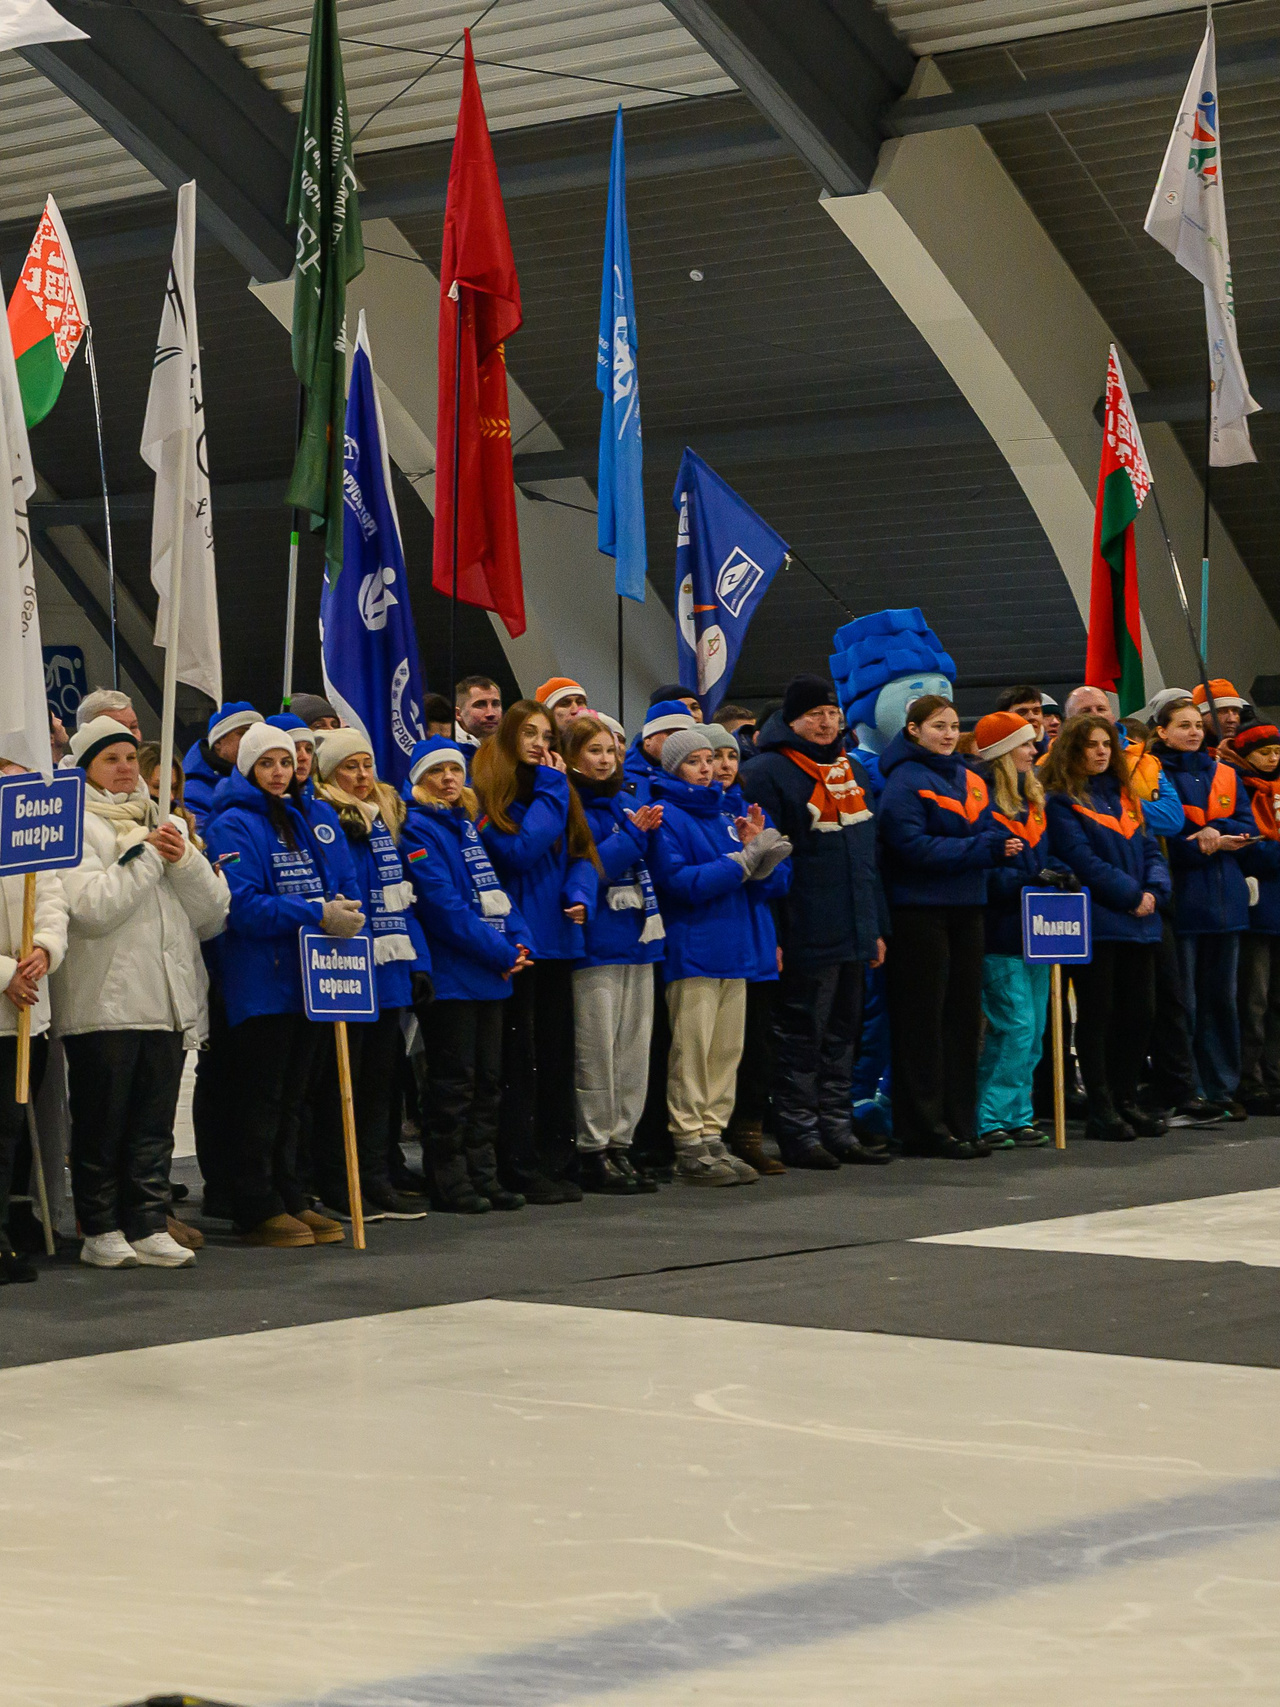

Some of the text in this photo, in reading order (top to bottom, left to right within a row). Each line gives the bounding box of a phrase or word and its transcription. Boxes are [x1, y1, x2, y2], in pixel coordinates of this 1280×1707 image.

[391, 709, 414, 752] СЕРВИ
[15, 794, 63, 819] Белые
[11, 825, 64, 851] тигры
[1032, 914, 1081, 936] Молния
[311, 948, 366, 971] Академия
[319, 977, 362, 1000] сервиса
